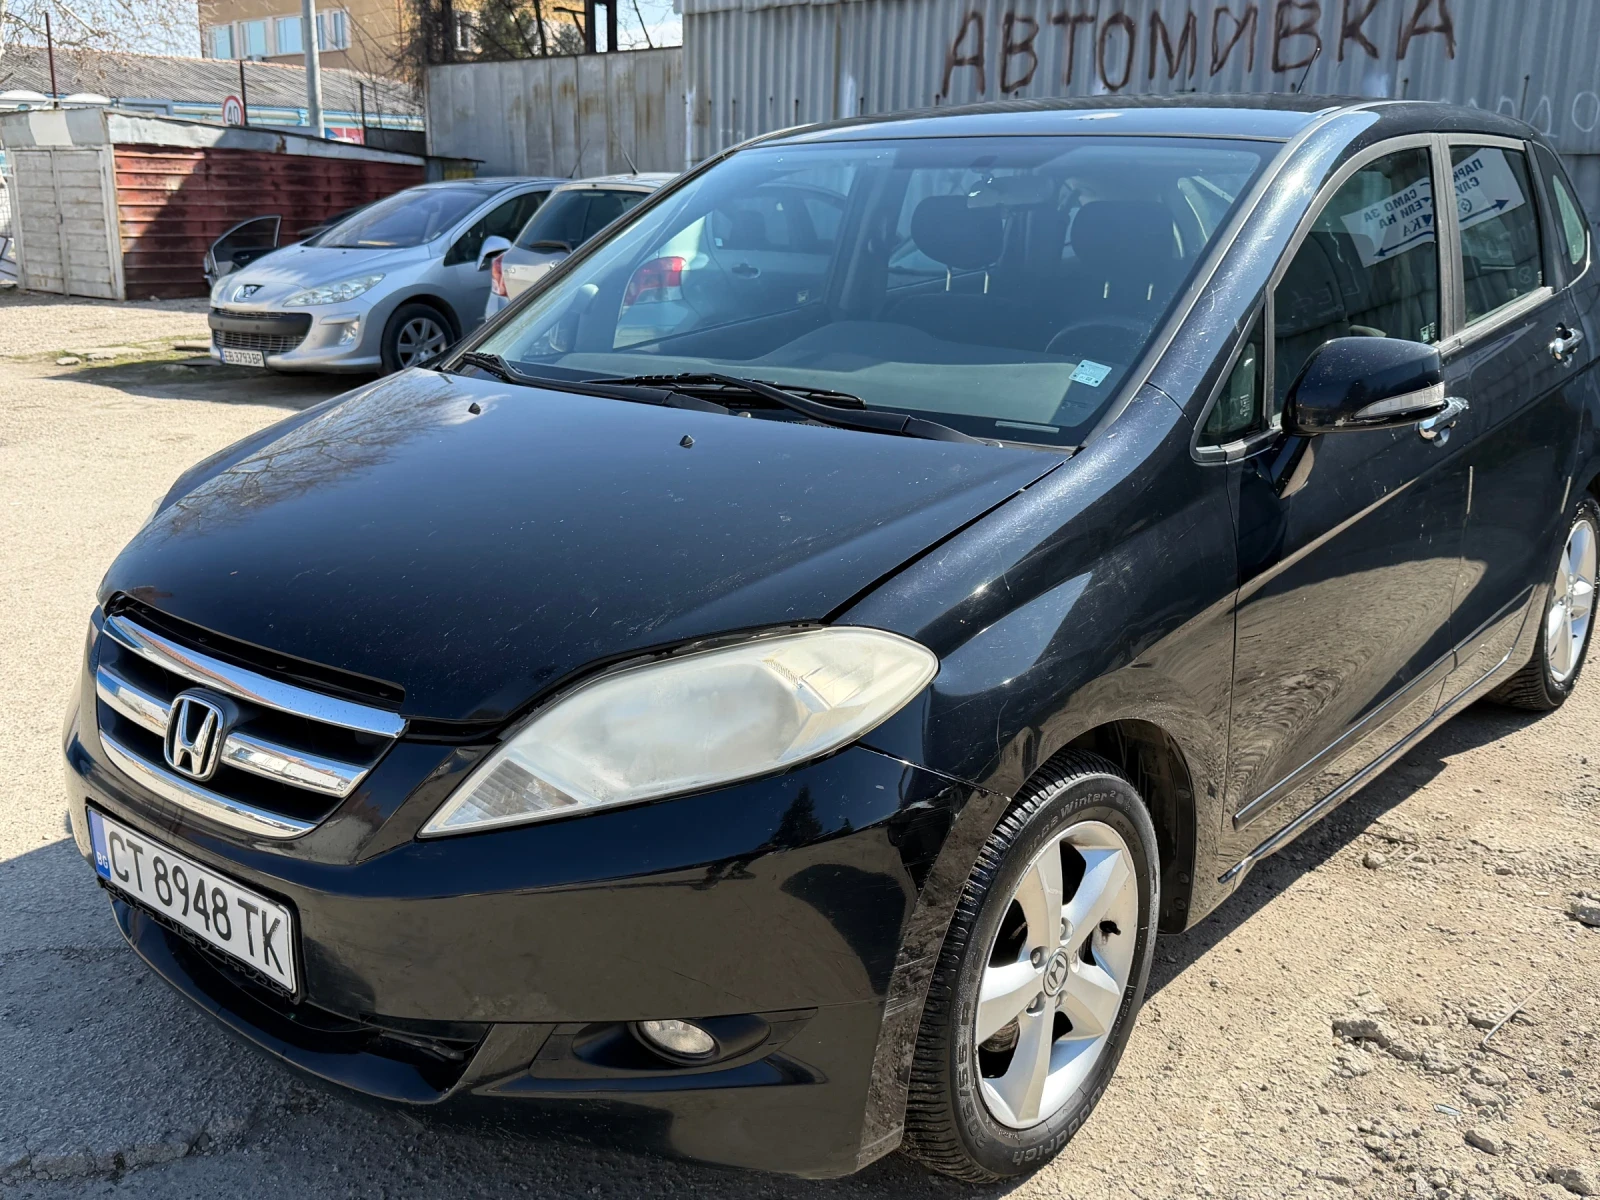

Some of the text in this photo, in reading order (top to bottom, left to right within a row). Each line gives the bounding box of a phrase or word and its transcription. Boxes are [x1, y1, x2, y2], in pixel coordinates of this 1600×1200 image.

[942, 0, 1456, 98] АВТОМИВКА
[227, 105, 240, 125] 40
[1060, 791, 1107, 818] Winter
[97, 852, 109, 869] BG
[109, 831, 285, 977] CT 8948 TK
